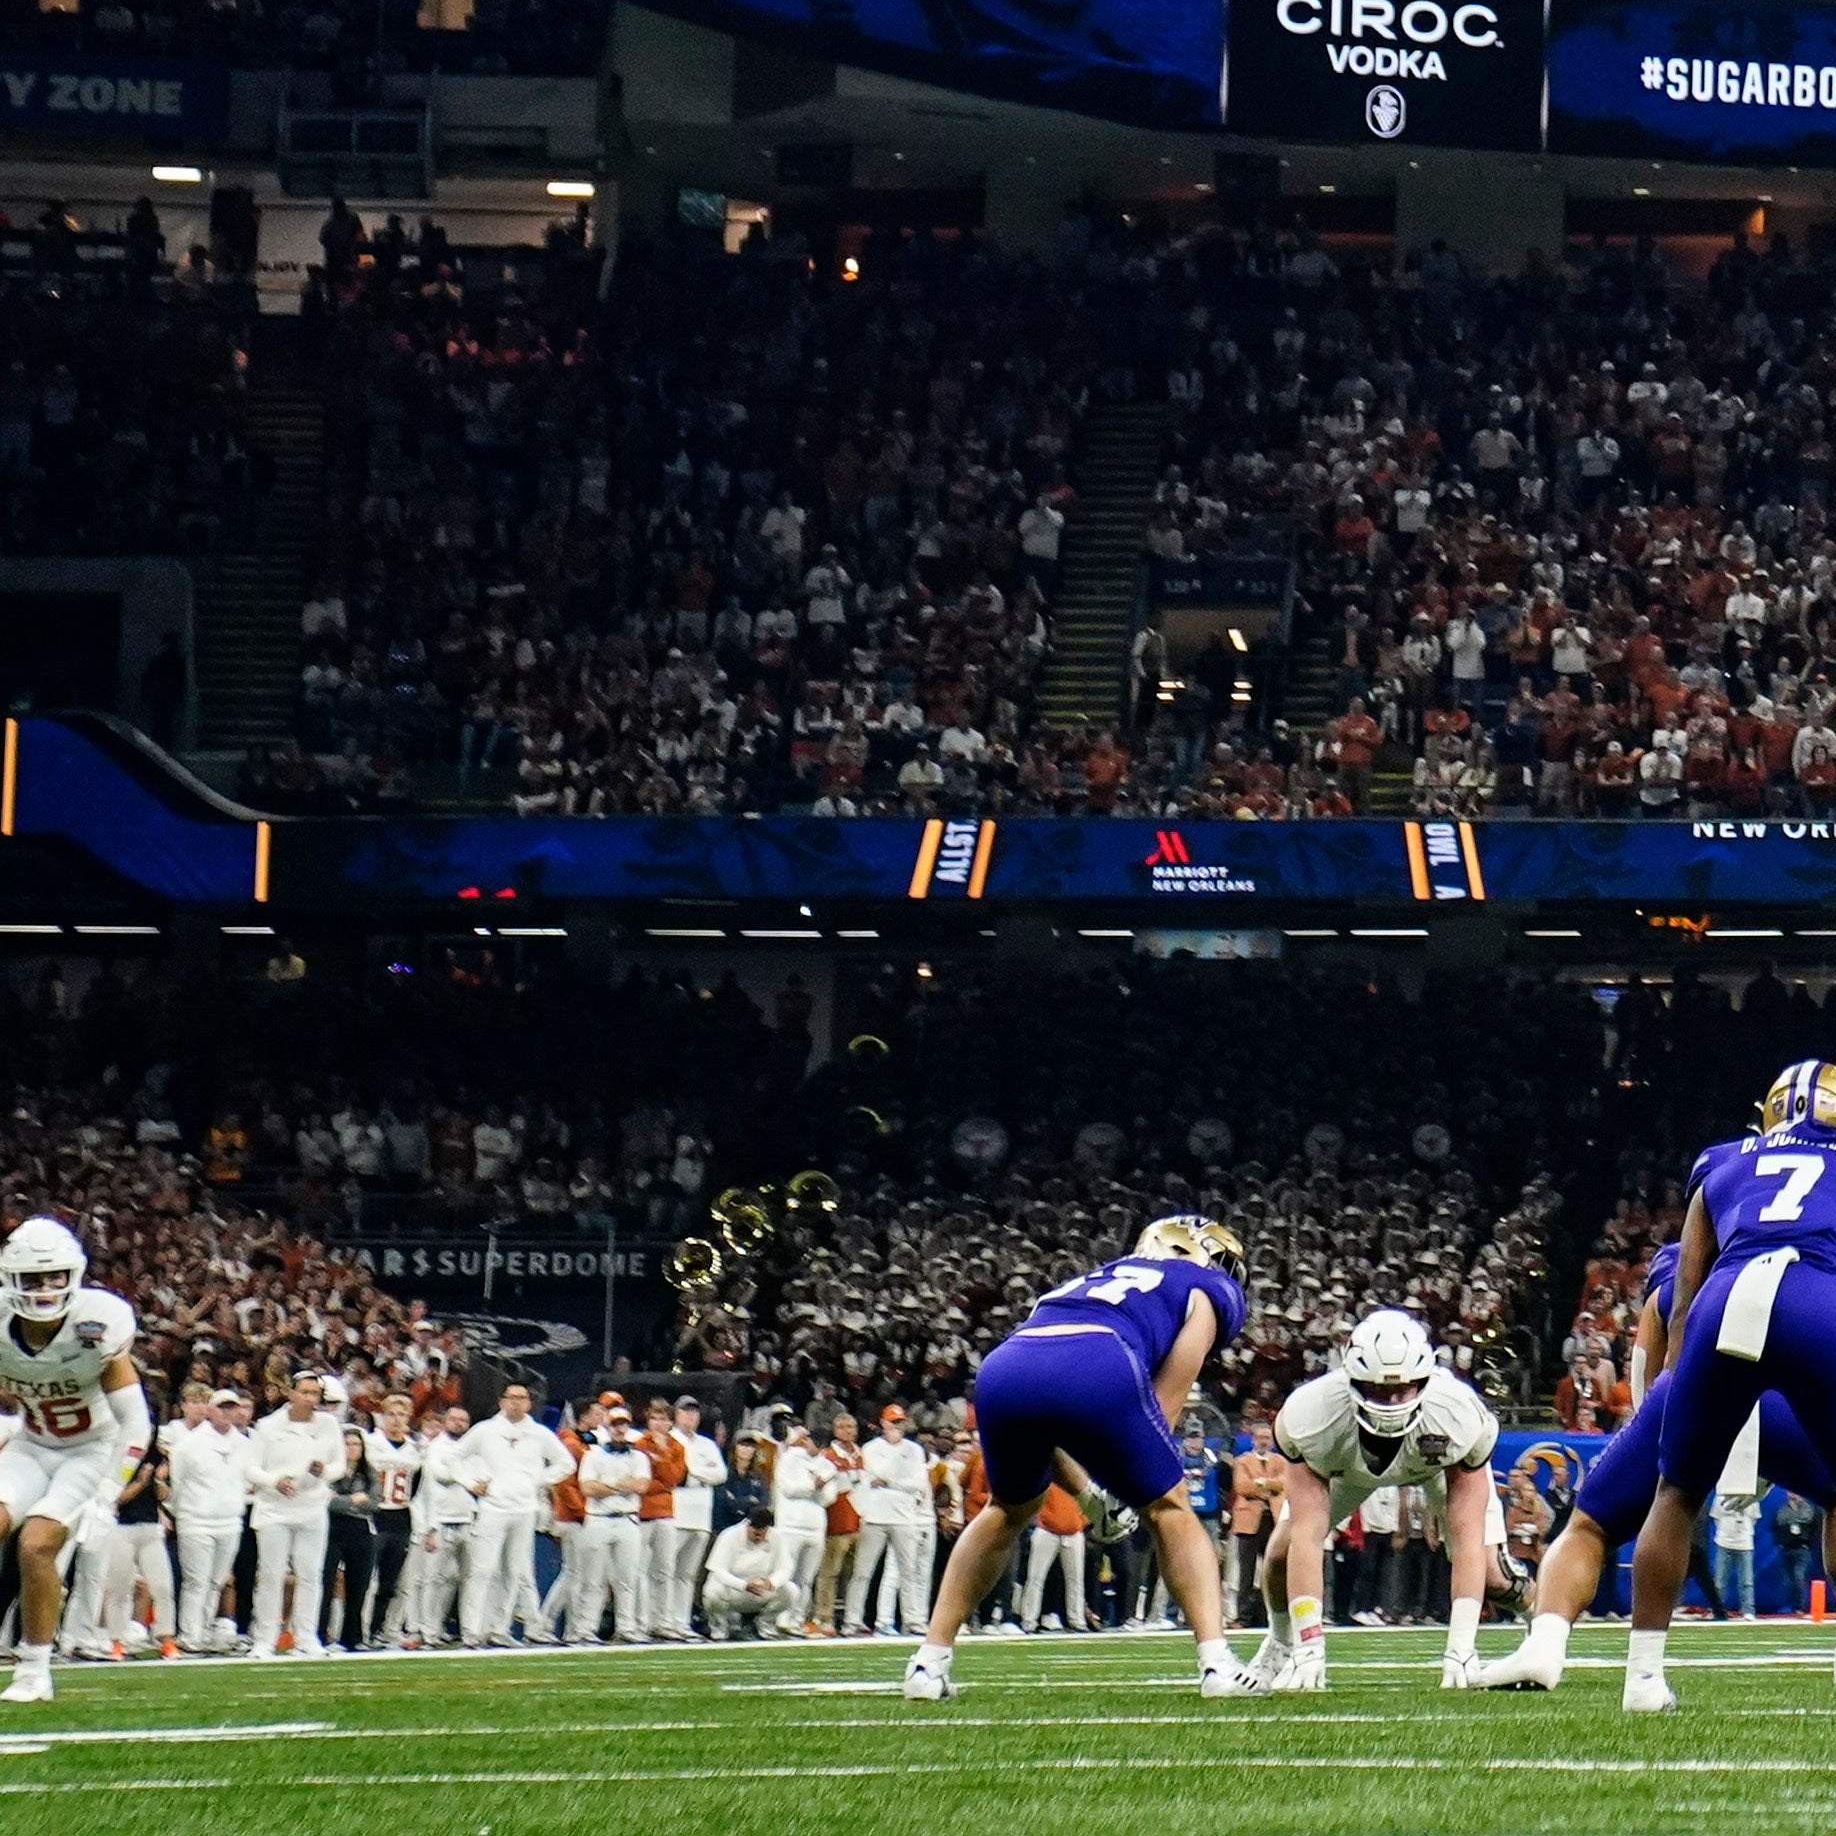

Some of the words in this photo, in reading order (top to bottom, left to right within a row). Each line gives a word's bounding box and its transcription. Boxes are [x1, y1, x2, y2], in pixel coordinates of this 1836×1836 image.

[1326, 44, 1448, 81] VODKA
[47, 75, 183, 117] ZONE
[1755, 1153, 1826, 1222] 7
